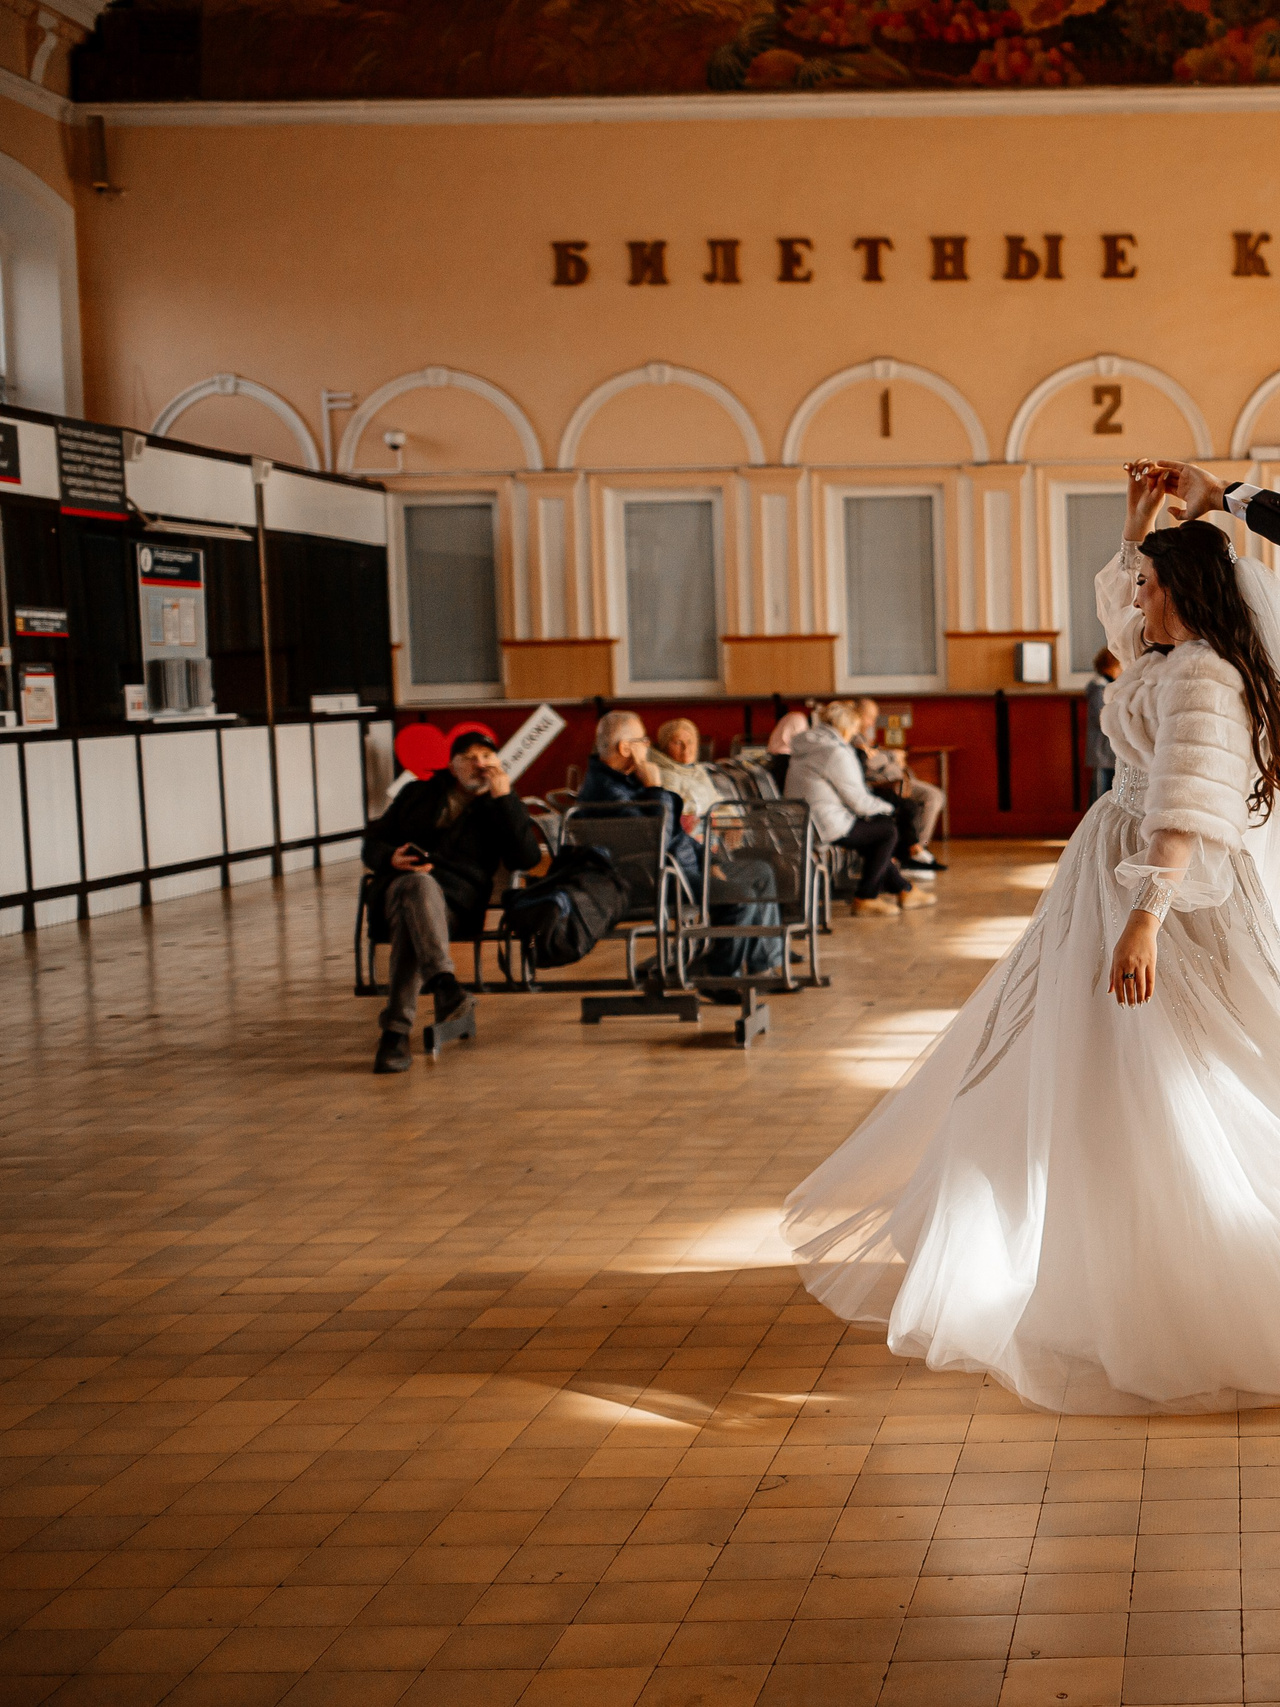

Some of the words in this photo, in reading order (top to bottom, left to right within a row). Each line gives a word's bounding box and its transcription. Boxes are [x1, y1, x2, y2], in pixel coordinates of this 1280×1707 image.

[551, 234, 1137, 286] БИЛЕТНЫЕ
[879, 388, 892, 438] 1
[1092, 385, 1123, 434] 2
